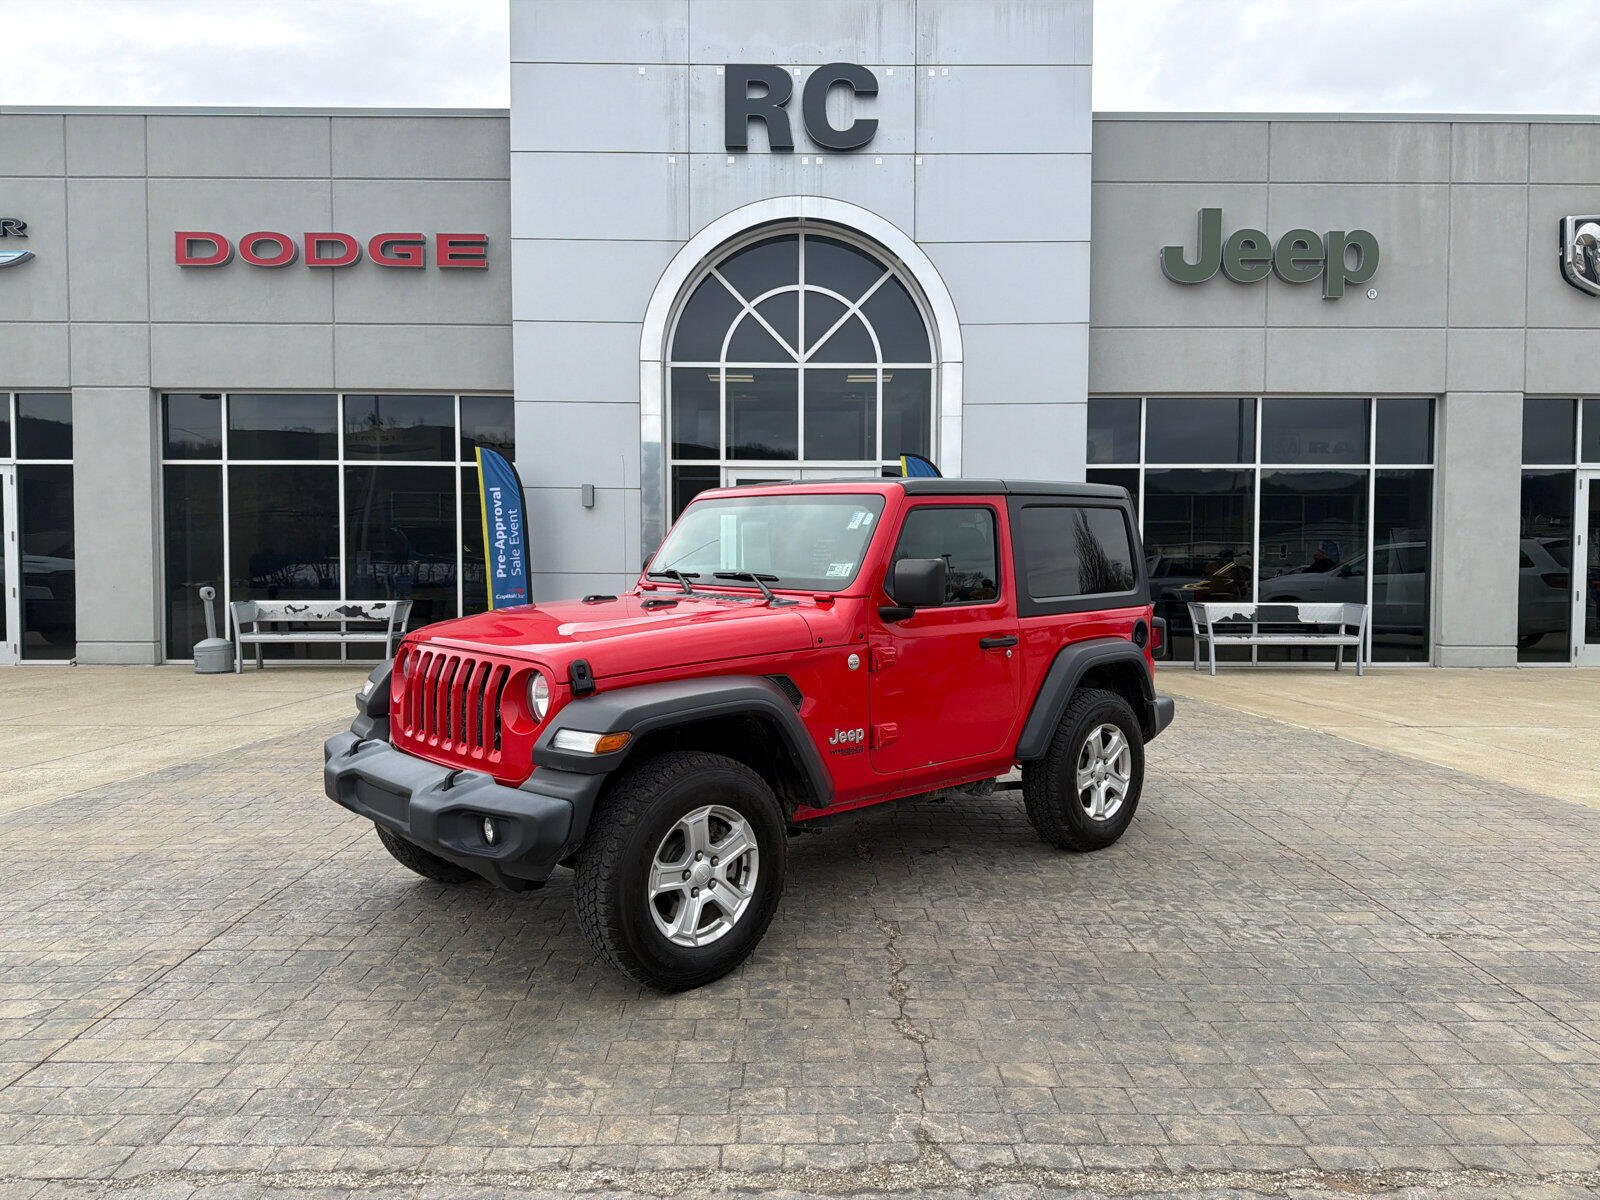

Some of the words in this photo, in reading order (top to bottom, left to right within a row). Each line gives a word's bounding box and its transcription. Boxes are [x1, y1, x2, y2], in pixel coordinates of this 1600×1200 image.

[725, 62, 879, 152] RC
[174, 231, 489, 269] DODGE
[1160, 208, 1380, 299] Jeep
[489, 487, 507, 578] Pre-Approval
[508, 508, 519, 545] Event
[510, 550, 521, 576] Sale
[829, 728, 864, 744] Jeep
